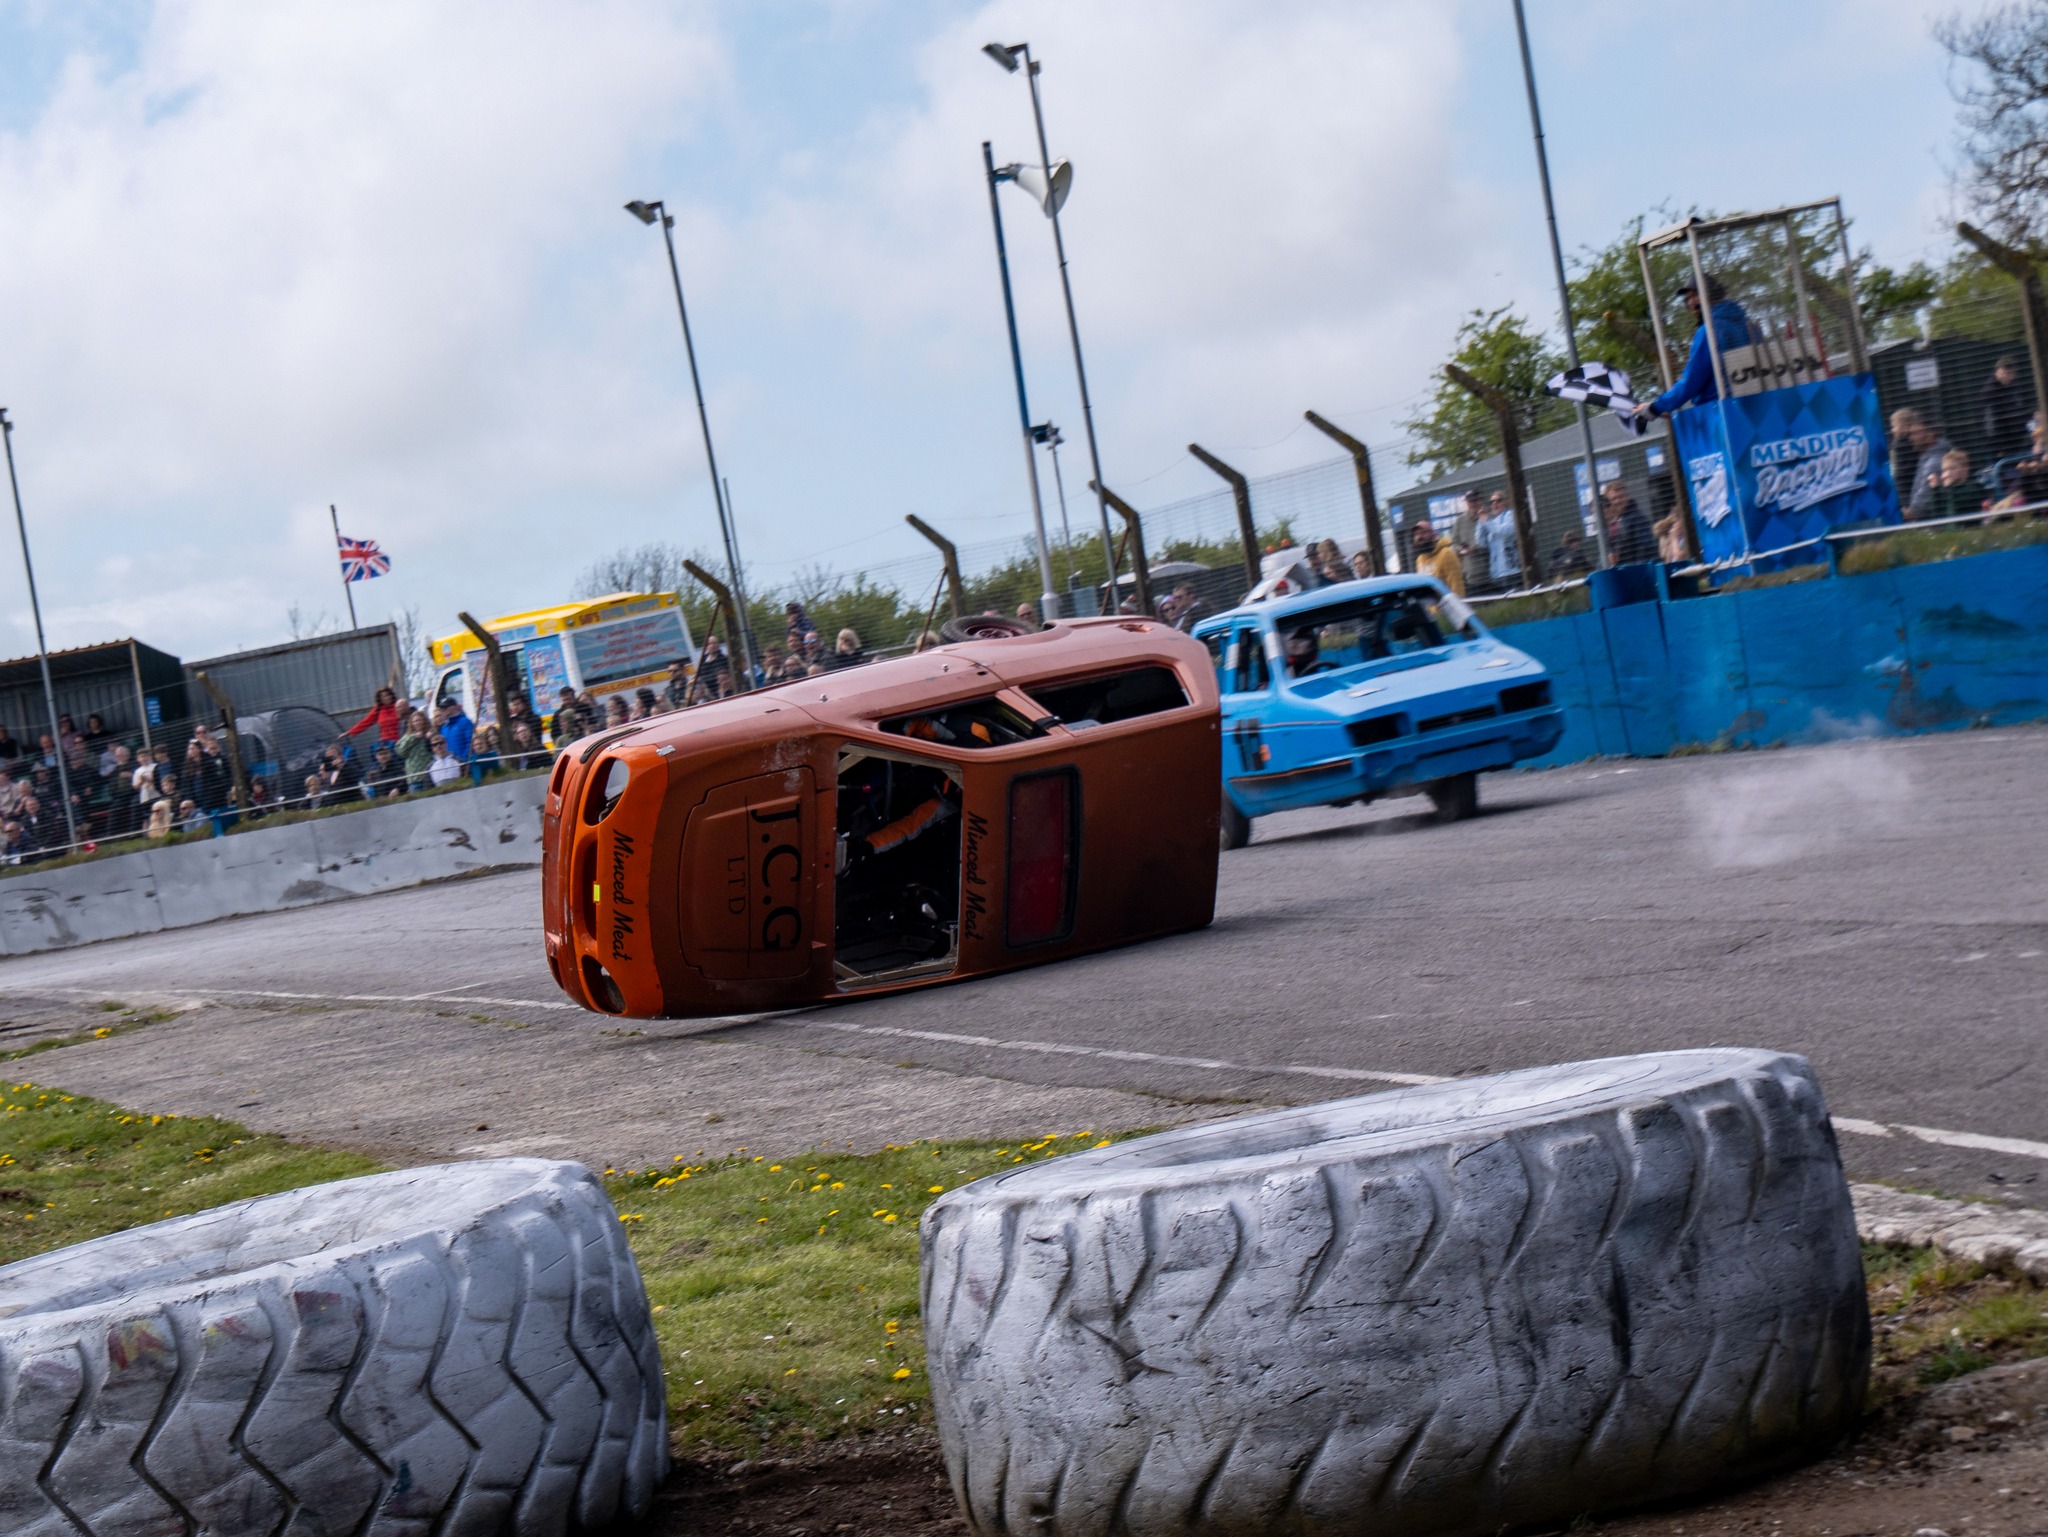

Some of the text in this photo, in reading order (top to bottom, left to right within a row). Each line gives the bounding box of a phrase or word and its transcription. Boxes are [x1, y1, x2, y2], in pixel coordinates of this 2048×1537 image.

[1754, 427, 1863, 463] MENDIPS
[612, 829, 635, 961] Minced Meat
[727, 856, 746, 915] LTD
[752, 803, 802, 950] J.C.G
[964, 811, 988, 942] Minced Meat
